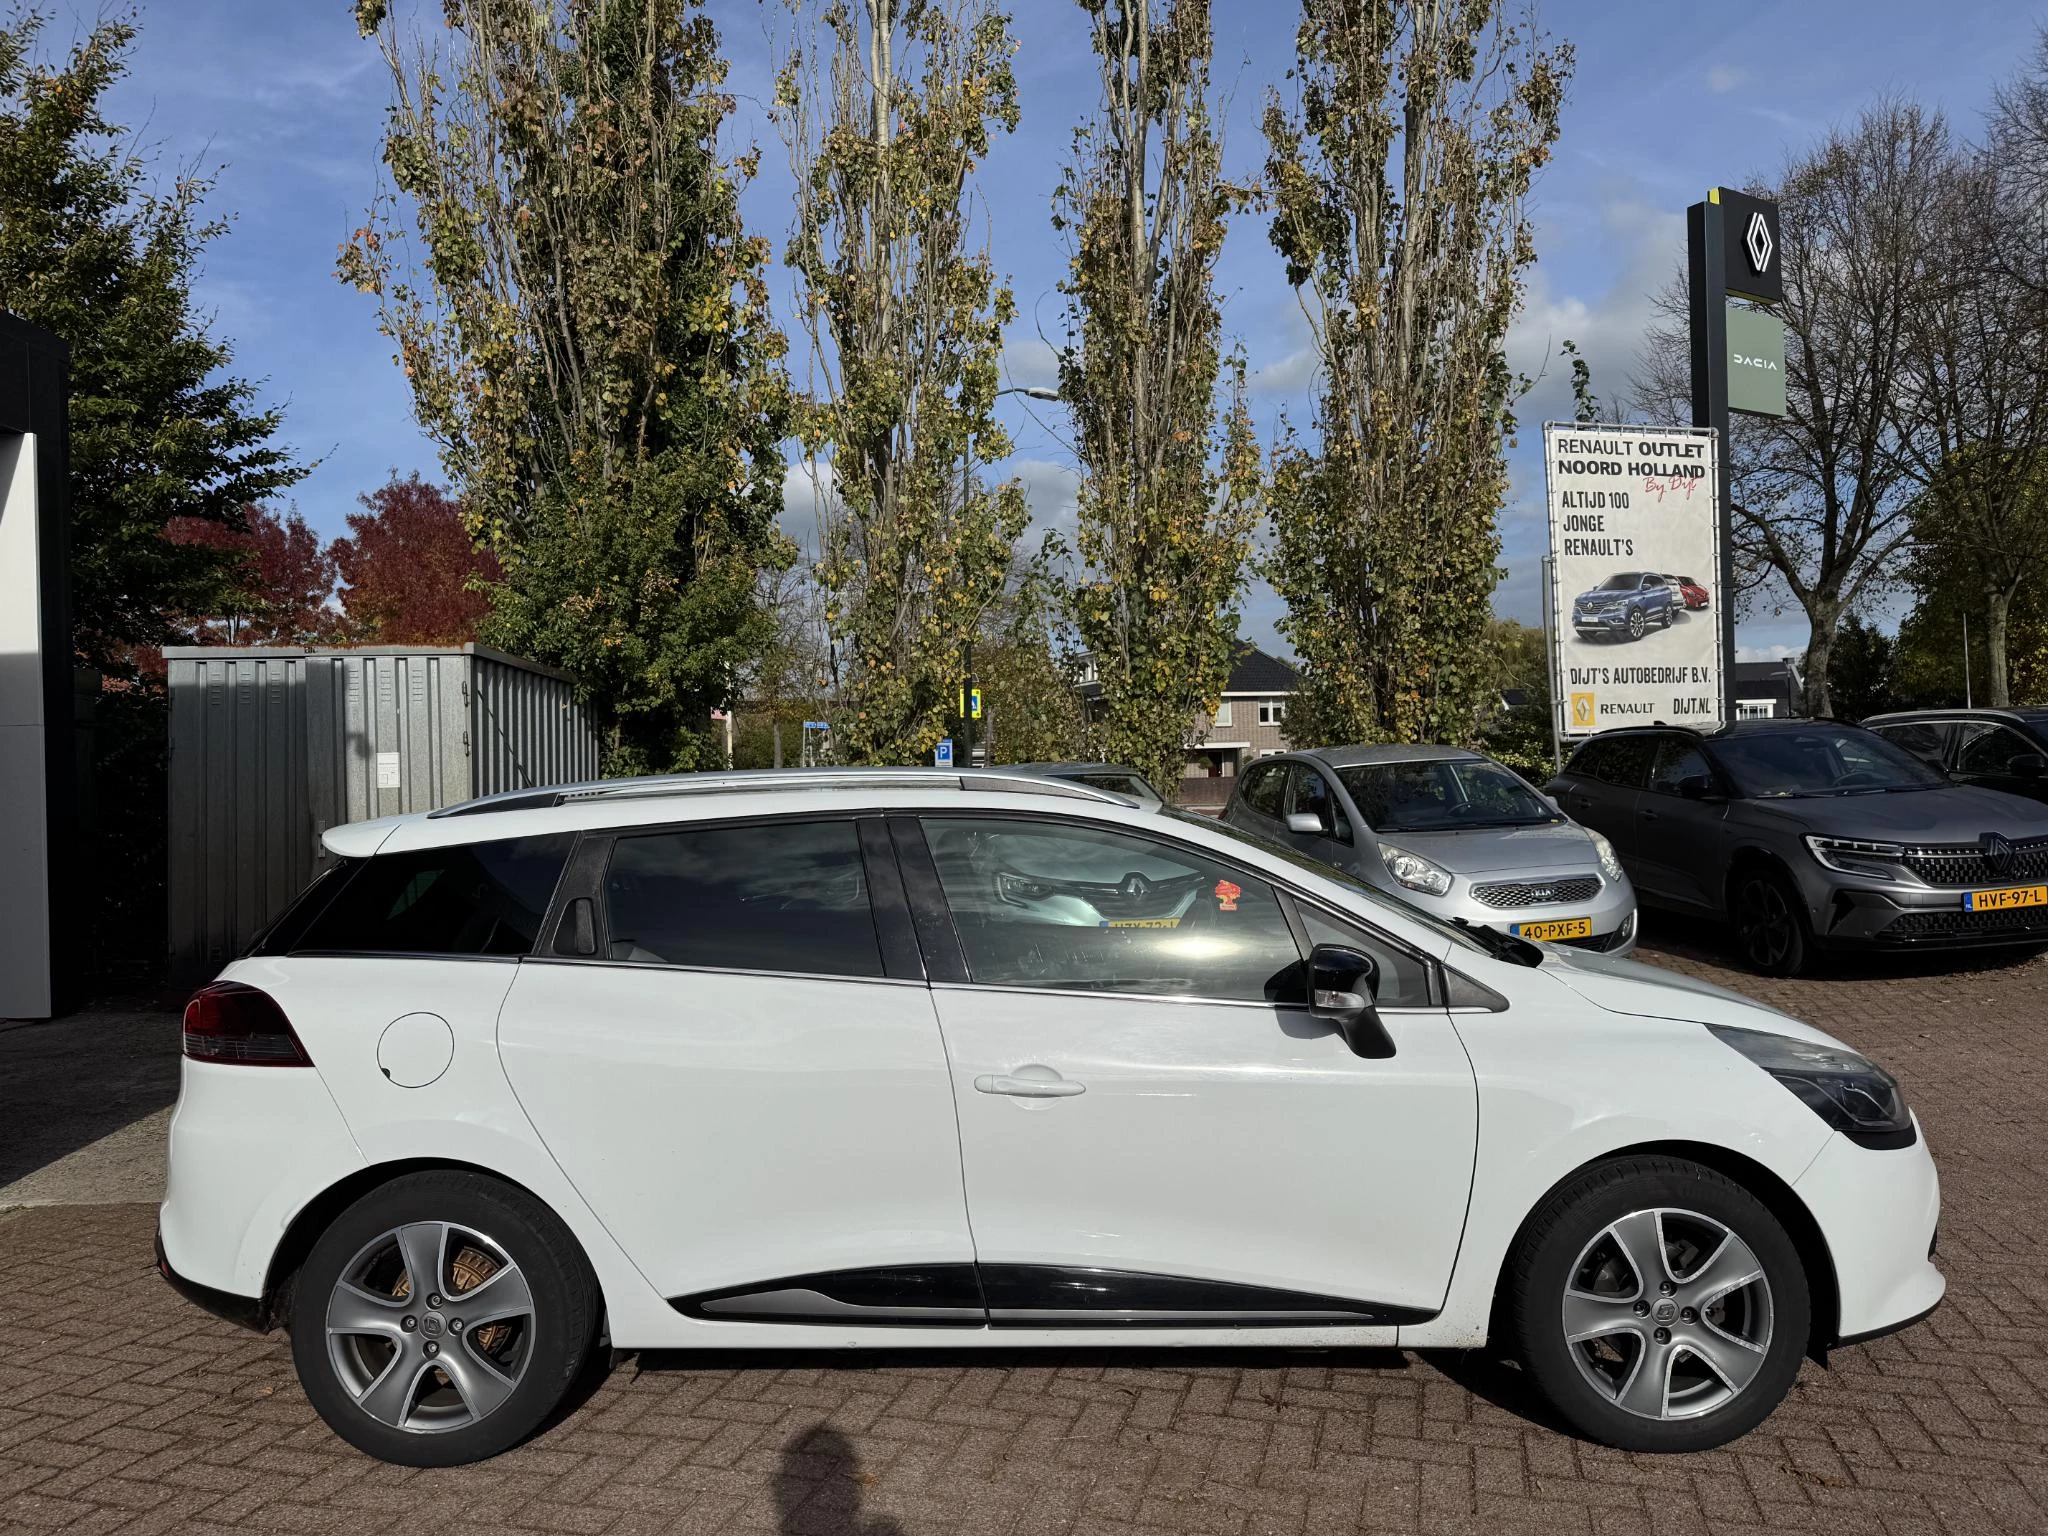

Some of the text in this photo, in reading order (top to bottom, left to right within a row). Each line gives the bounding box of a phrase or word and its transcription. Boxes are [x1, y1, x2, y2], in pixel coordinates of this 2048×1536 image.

[1733, 353, 1777, 371] DACIA
[1558, 439, 1704, 458] RENAULT OUTLET
[1558, 460, 1706, 478] NOORD HOLLAND
[1643, 476, 1667, 502] By
[1562, 491, 1629, 509] ALTIJD 100
[1563, 515, 1605, 532] JONGE
[1564, 538, 1633, 556] RENAULT'S
[1570, 667, 1711, 684] DIJT'S AUTOBEDRIJF B.V.
[1600, 698, 1711, 714] RENAULT DIJT.NL
[1534, 889, 1551, 897] KIA
[1979, 889, 2042, 908] HVF-97-L
[1524, 921, 1586, 939] 40-PXF-5
